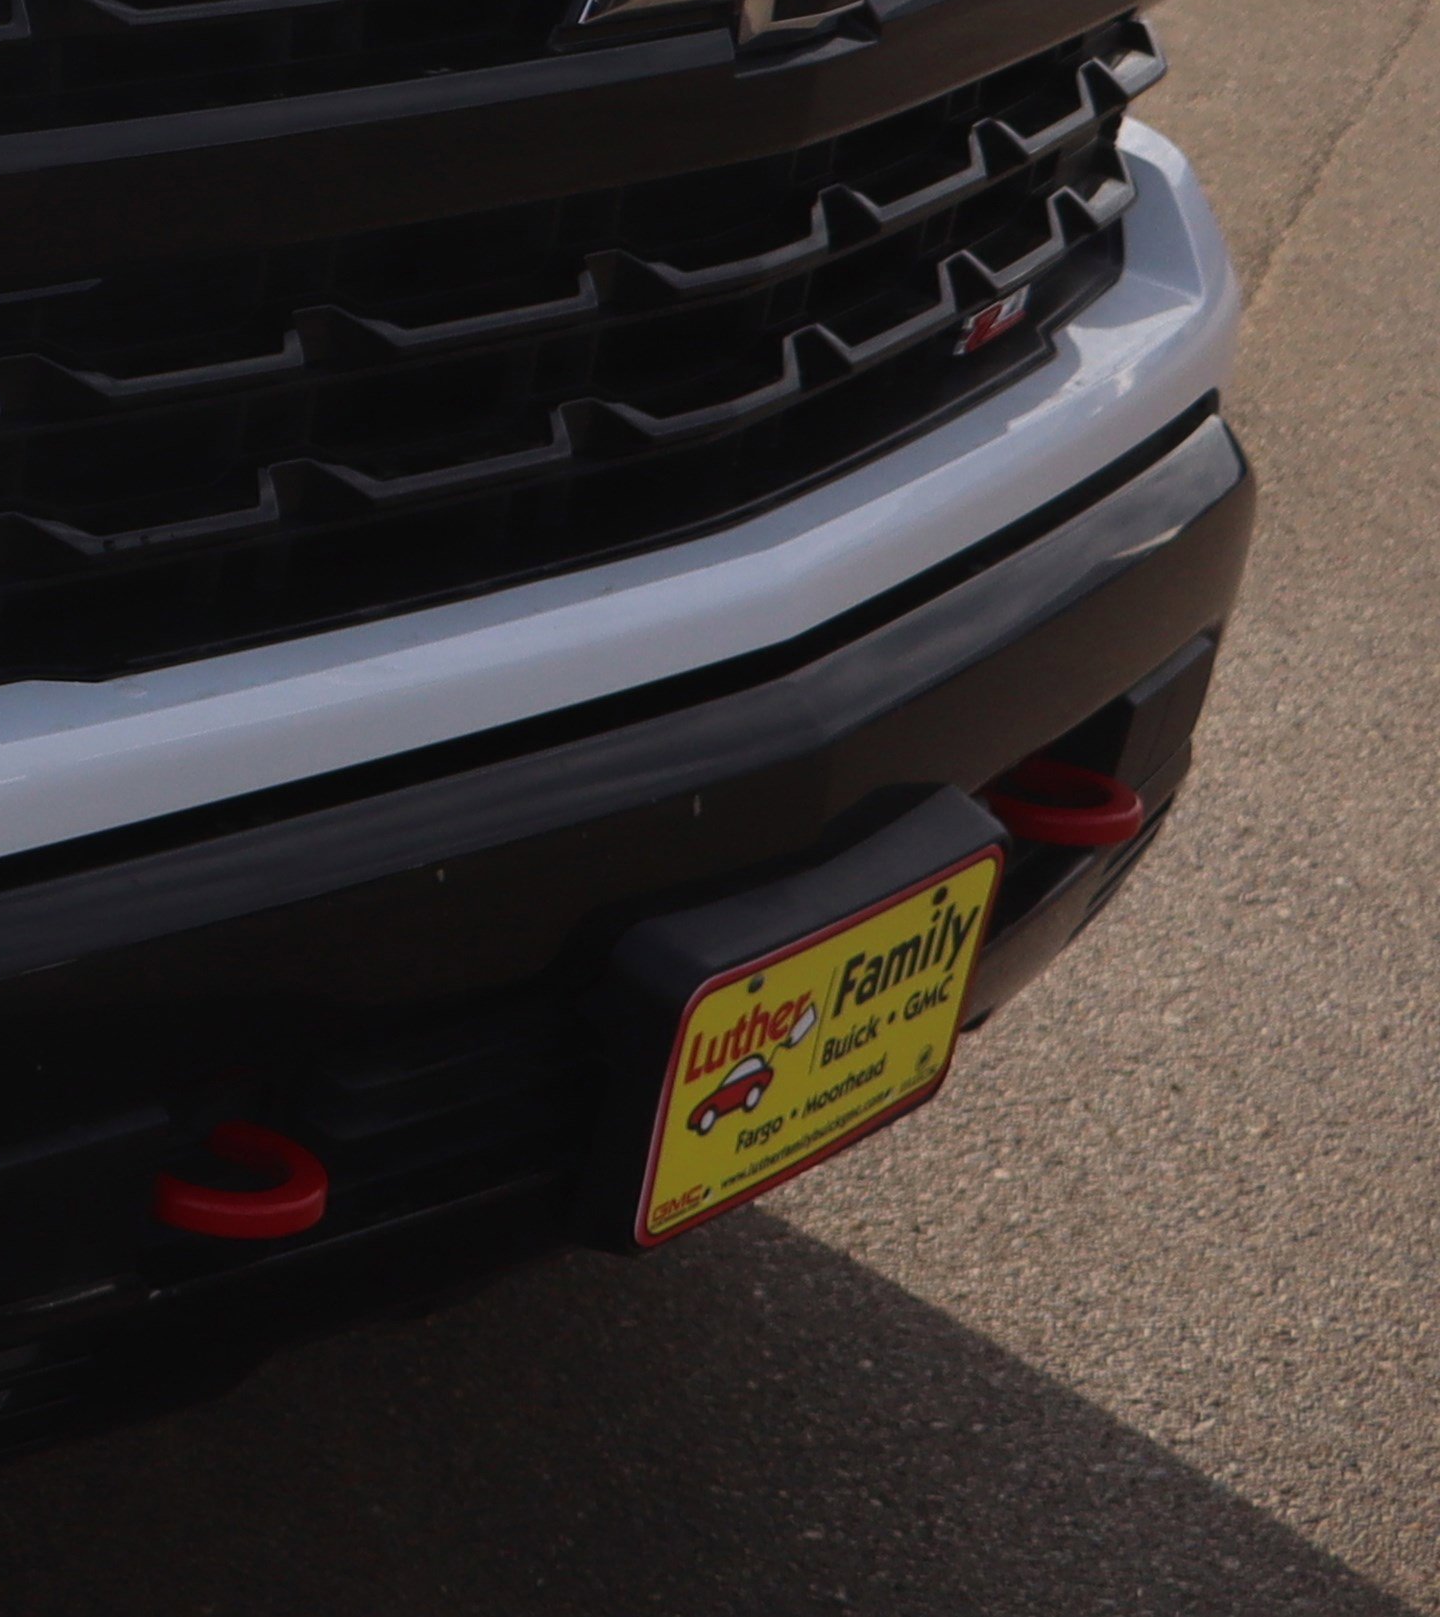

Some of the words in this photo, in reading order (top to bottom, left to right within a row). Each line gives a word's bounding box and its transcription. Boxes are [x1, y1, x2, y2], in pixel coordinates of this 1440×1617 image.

[683, 990, 813, 1085] Luther
[832, 903, 980, 1019] Family
[820, 1015, 883, 1068] Buick
[903, 974, 955, 1021] GMC
[736, 1115, 784, 1154] Fargo
[801, 1051, 888, 1118] Moorhead
[651, 1185, 703, 1222] GMC
